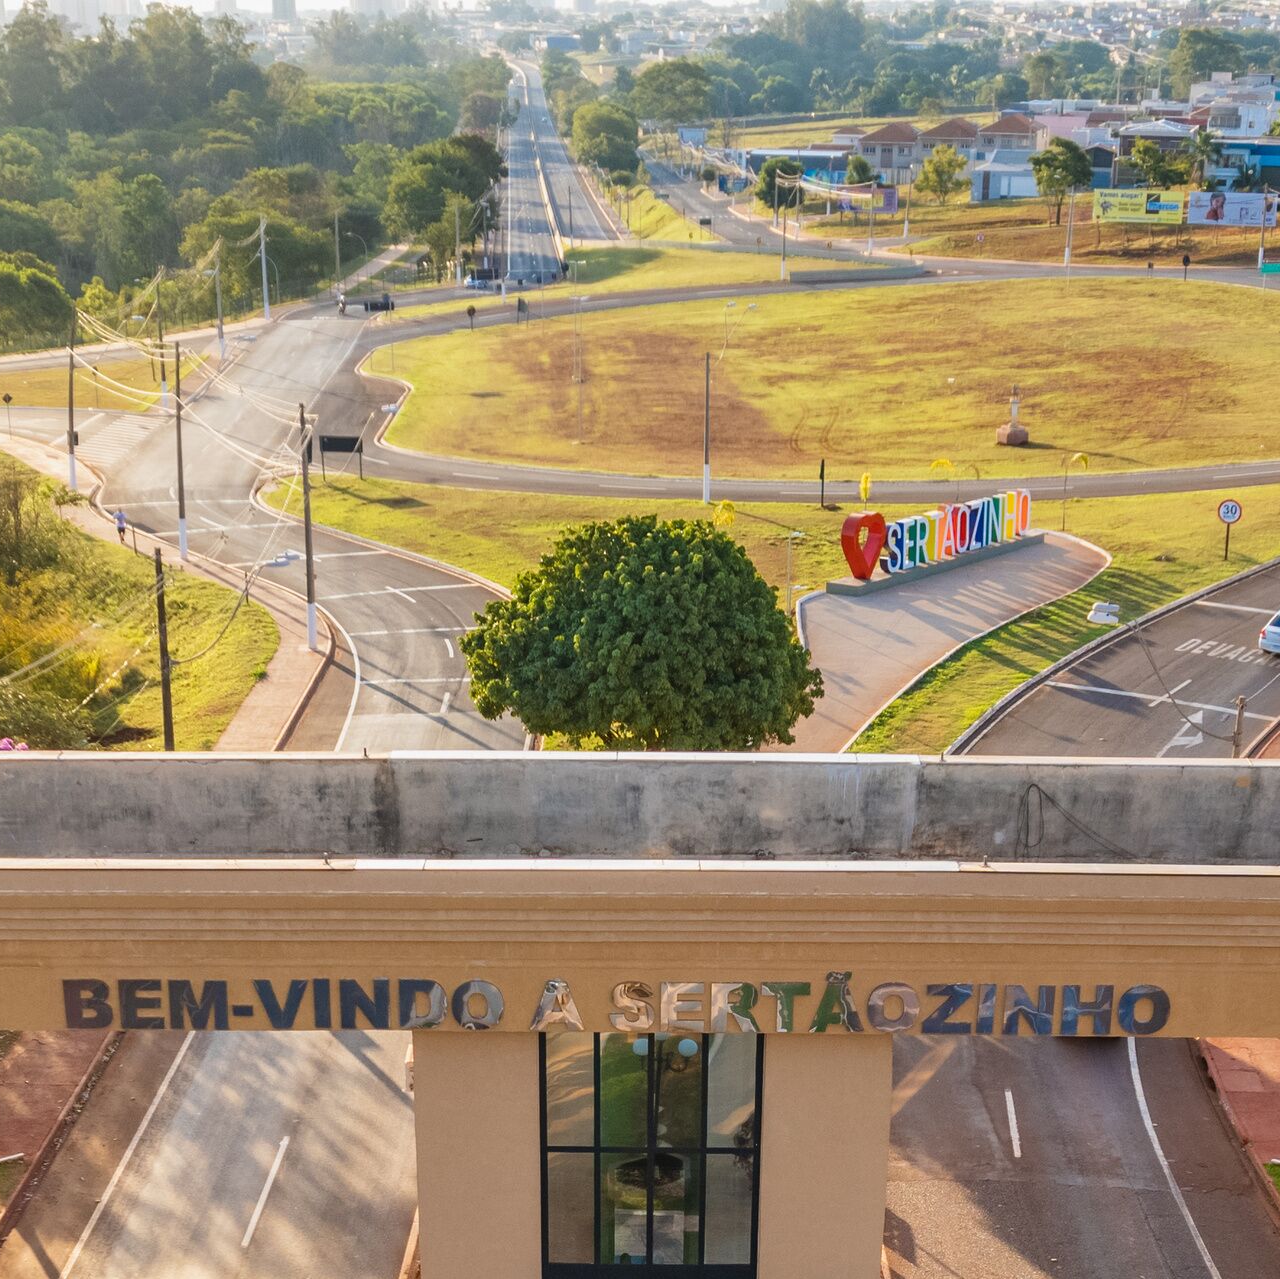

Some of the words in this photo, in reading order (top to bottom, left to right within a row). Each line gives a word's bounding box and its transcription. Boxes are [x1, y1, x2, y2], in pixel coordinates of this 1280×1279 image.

[881, 488, 1032, 573] SERTÃOZINHO
[1223, 504, 1237, 515] 30
[63, 976, 505, 1030] BEM-VINDO
[530, 978, 585, 1031] A
[609, 971, 1172, 1035] SERTÃOZINHO
